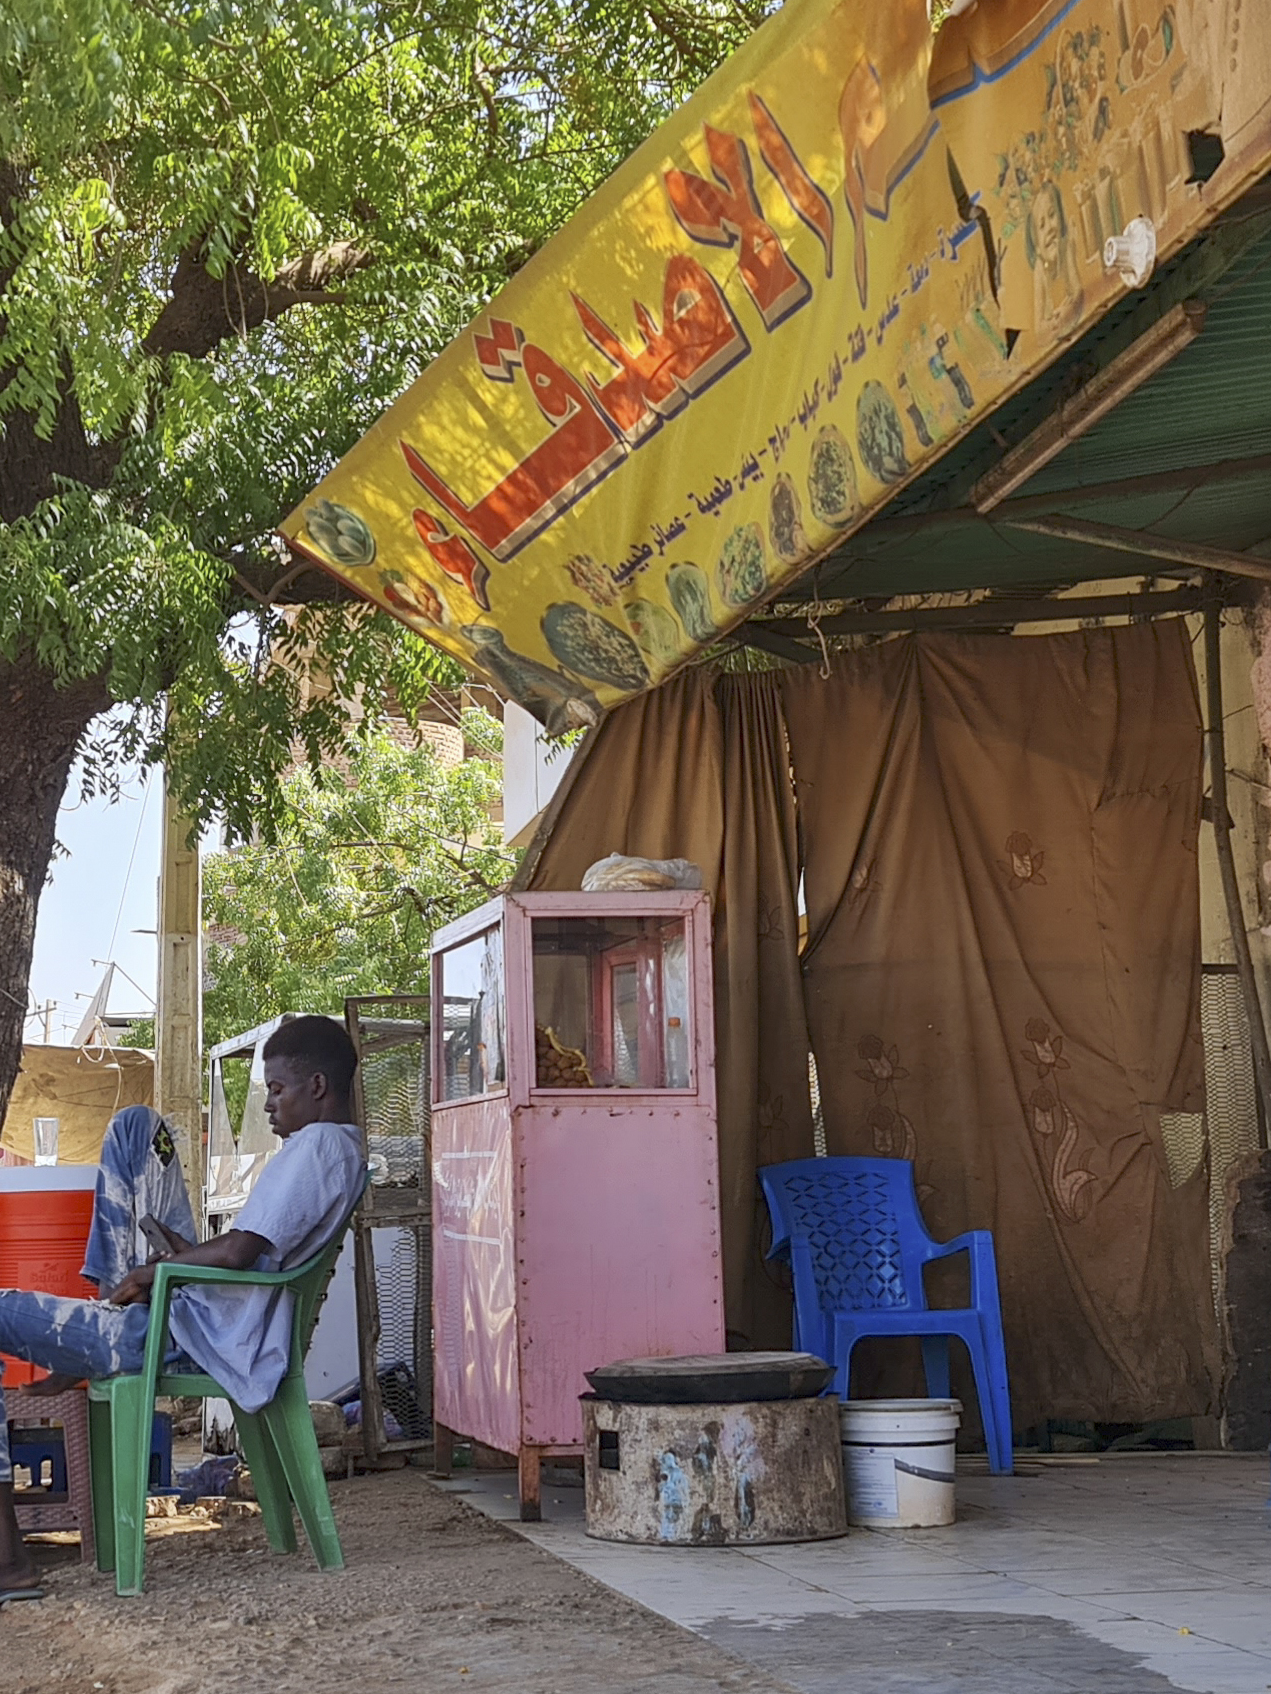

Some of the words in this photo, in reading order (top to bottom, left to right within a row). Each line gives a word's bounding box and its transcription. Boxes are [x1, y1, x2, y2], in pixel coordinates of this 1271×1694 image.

[687, 475, 733, 517] طعمية
[649, 515, 687, 557] عصائر
[601, 543, 654, 590] طبيعية
